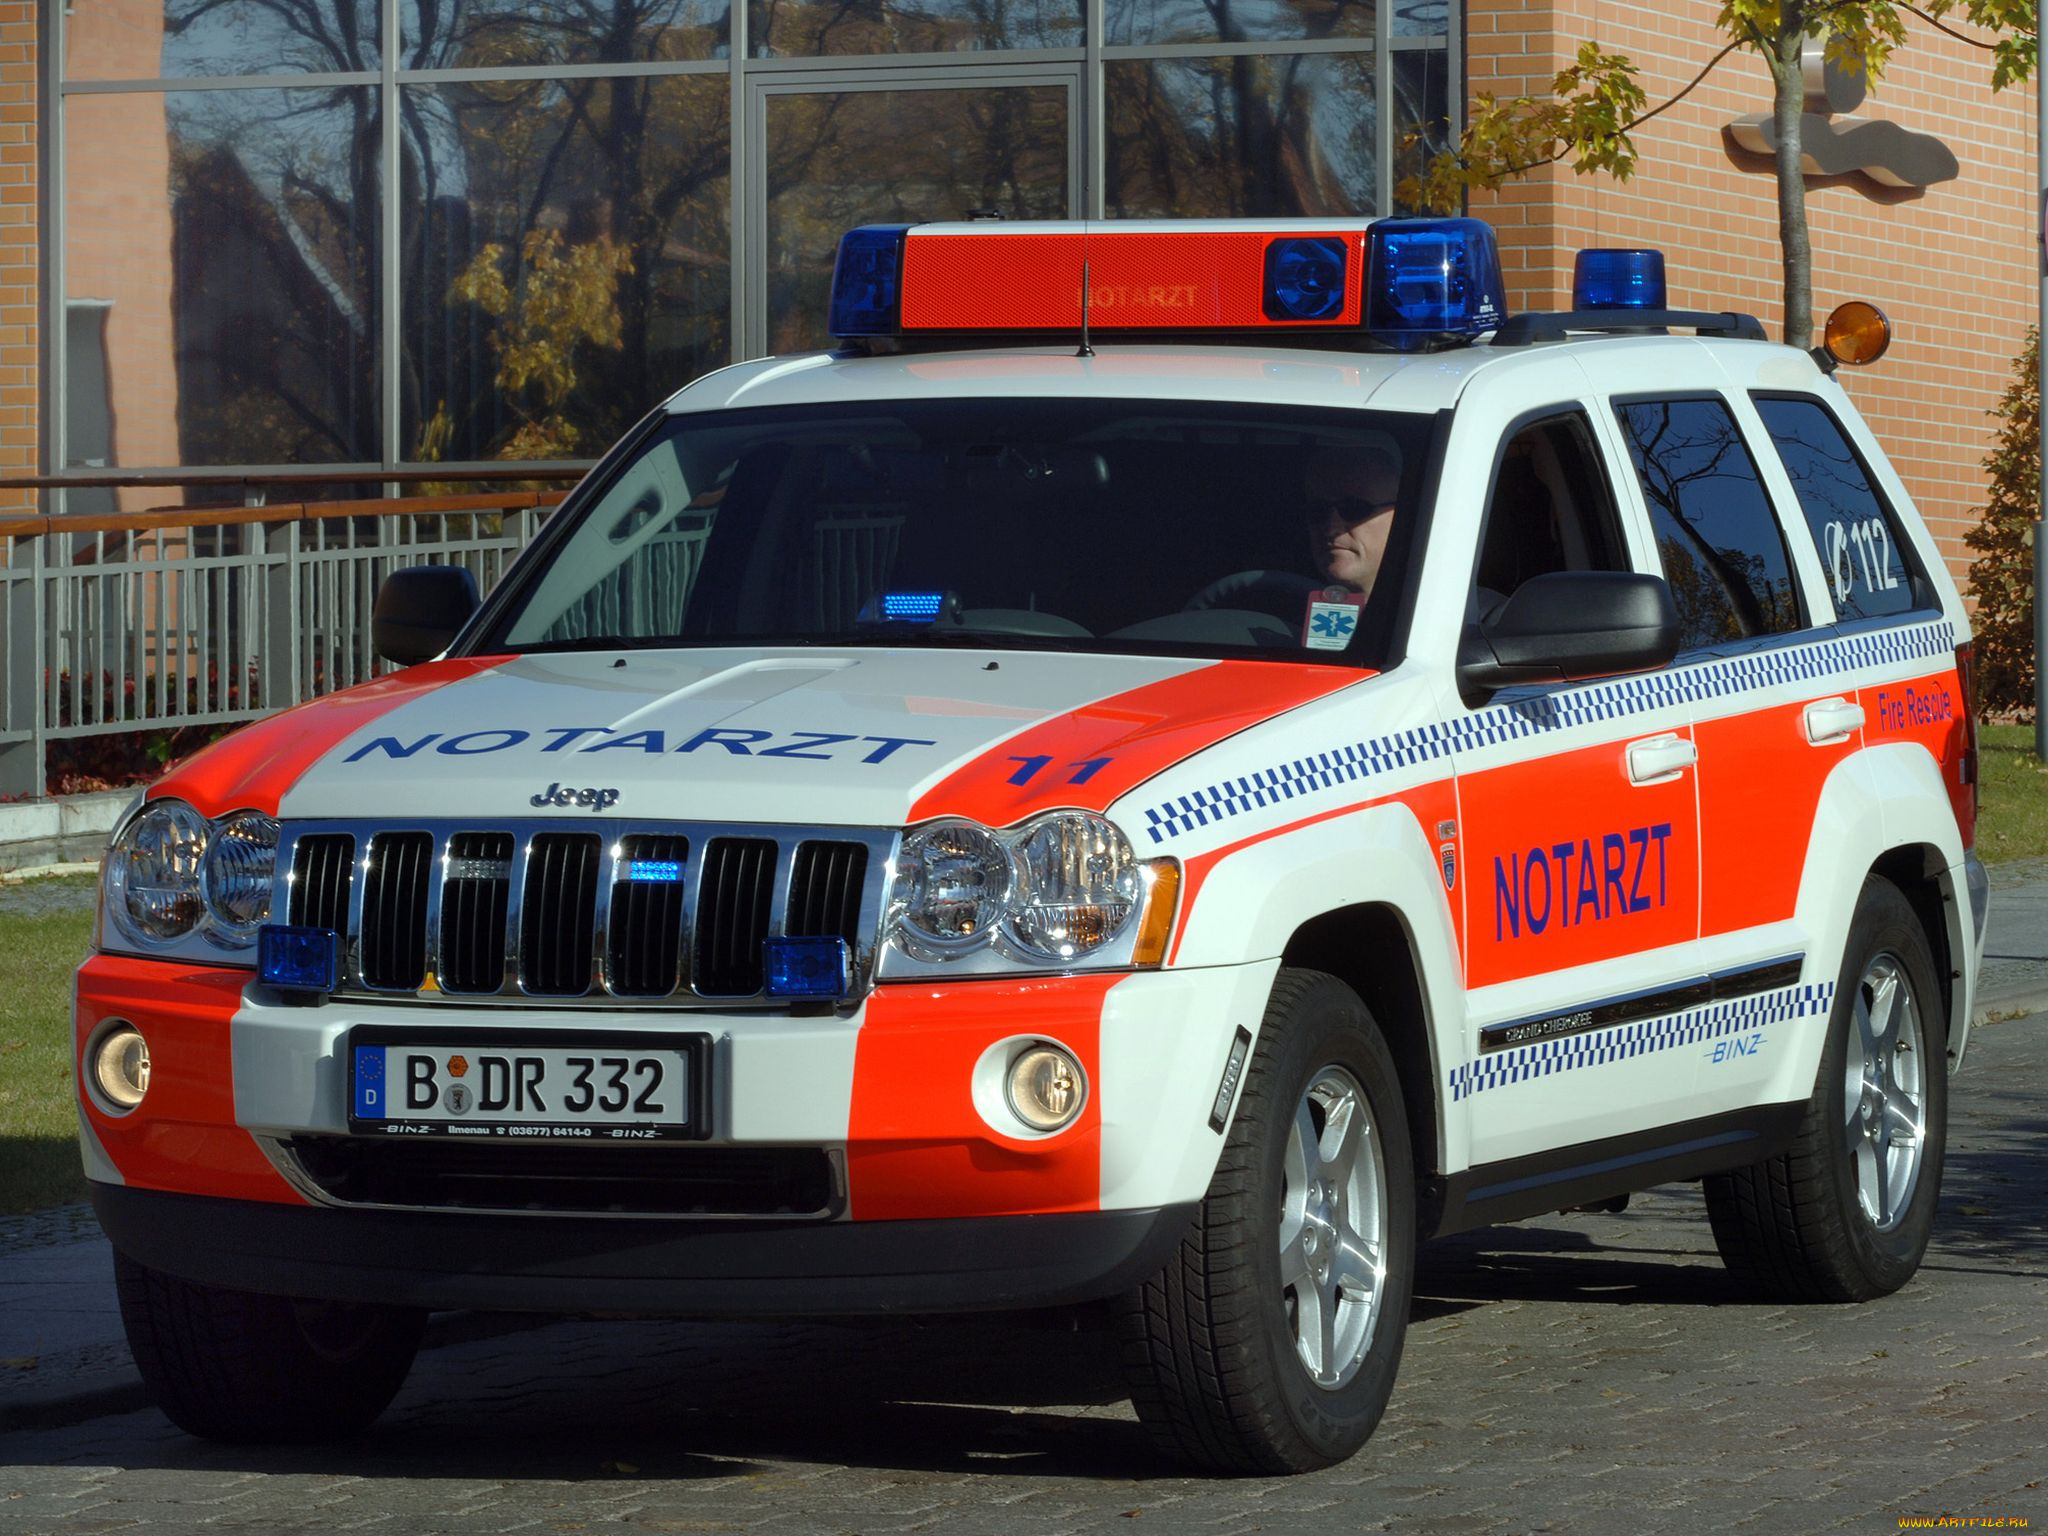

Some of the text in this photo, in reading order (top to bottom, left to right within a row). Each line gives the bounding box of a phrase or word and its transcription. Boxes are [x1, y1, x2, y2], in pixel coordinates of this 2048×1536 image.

[1851, 518, 1898, 593] 112
[1878, 687, 1952, 732] Fire Rescue
[343, 727, 935, 765] NOTARZT
[1005, 755, 1114, 786] 11
[530, 782, 619, 812] Jeep
[1494, 822, 1672, 942] NOTARZT
[1505, 1011, 1593, 1042] GRAND CHEROKEE
[365, 1089, 377, 1105] D
[406, 1055, 665, 1114] B DR 332
[448, 1125, 490, 1135] Ilmenau
[508, 1126, 550, 1137] (03677)
[553, 1128, 592, 1137] 6414-0
